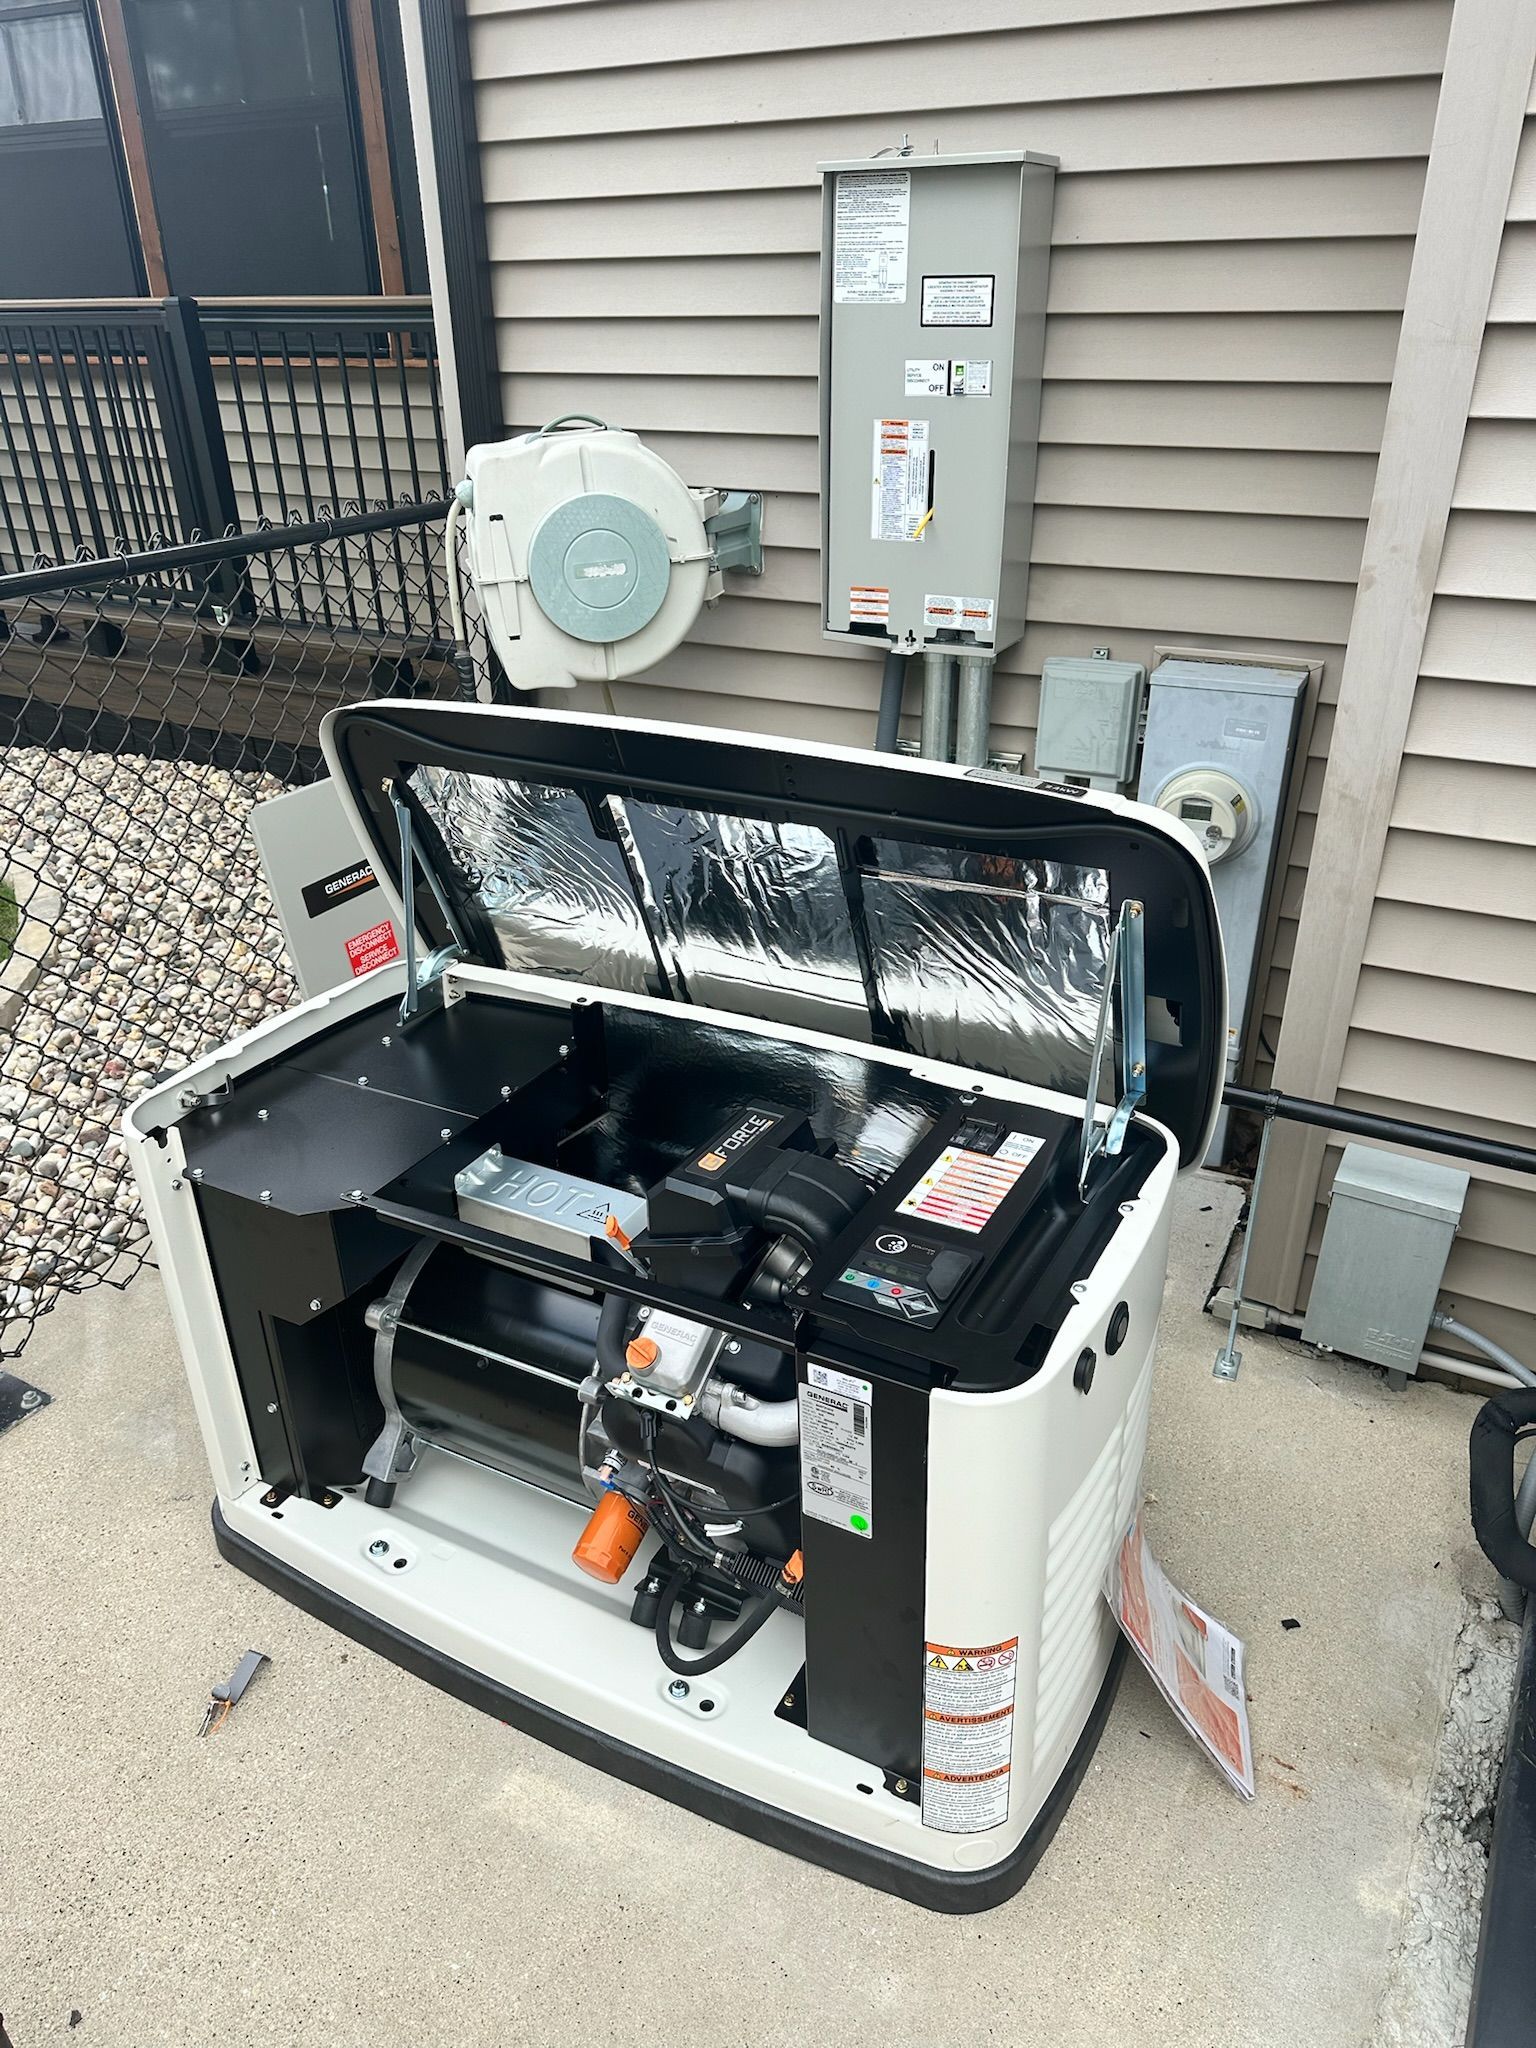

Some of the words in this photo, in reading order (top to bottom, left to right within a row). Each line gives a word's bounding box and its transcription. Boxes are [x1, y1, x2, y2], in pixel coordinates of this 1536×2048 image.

[932, 363, 945, 371] ON
[928, 384, 945, 392] OFF
[324, 865, 373, 895] GENERAC
[347, 922, 391, 950] EMERGENCY
[349, 930, 392, 958] DISCONNECT
[354, 947, 398, 976] DISCONNECT
[360, 943, 389, 964] SERVICE
[491, 1170, 595, 1215] HOT
[650, 1321, 698, 1343] GENERAC
[806, 1390, 849, 1410] GENERAC
[958, 1646, 1003, 1657] WARNING
[939, 1708, 1012, 1724] AVERTISSEMENT
[943, 1768, 1005, 1782] ADVERTENCIA
